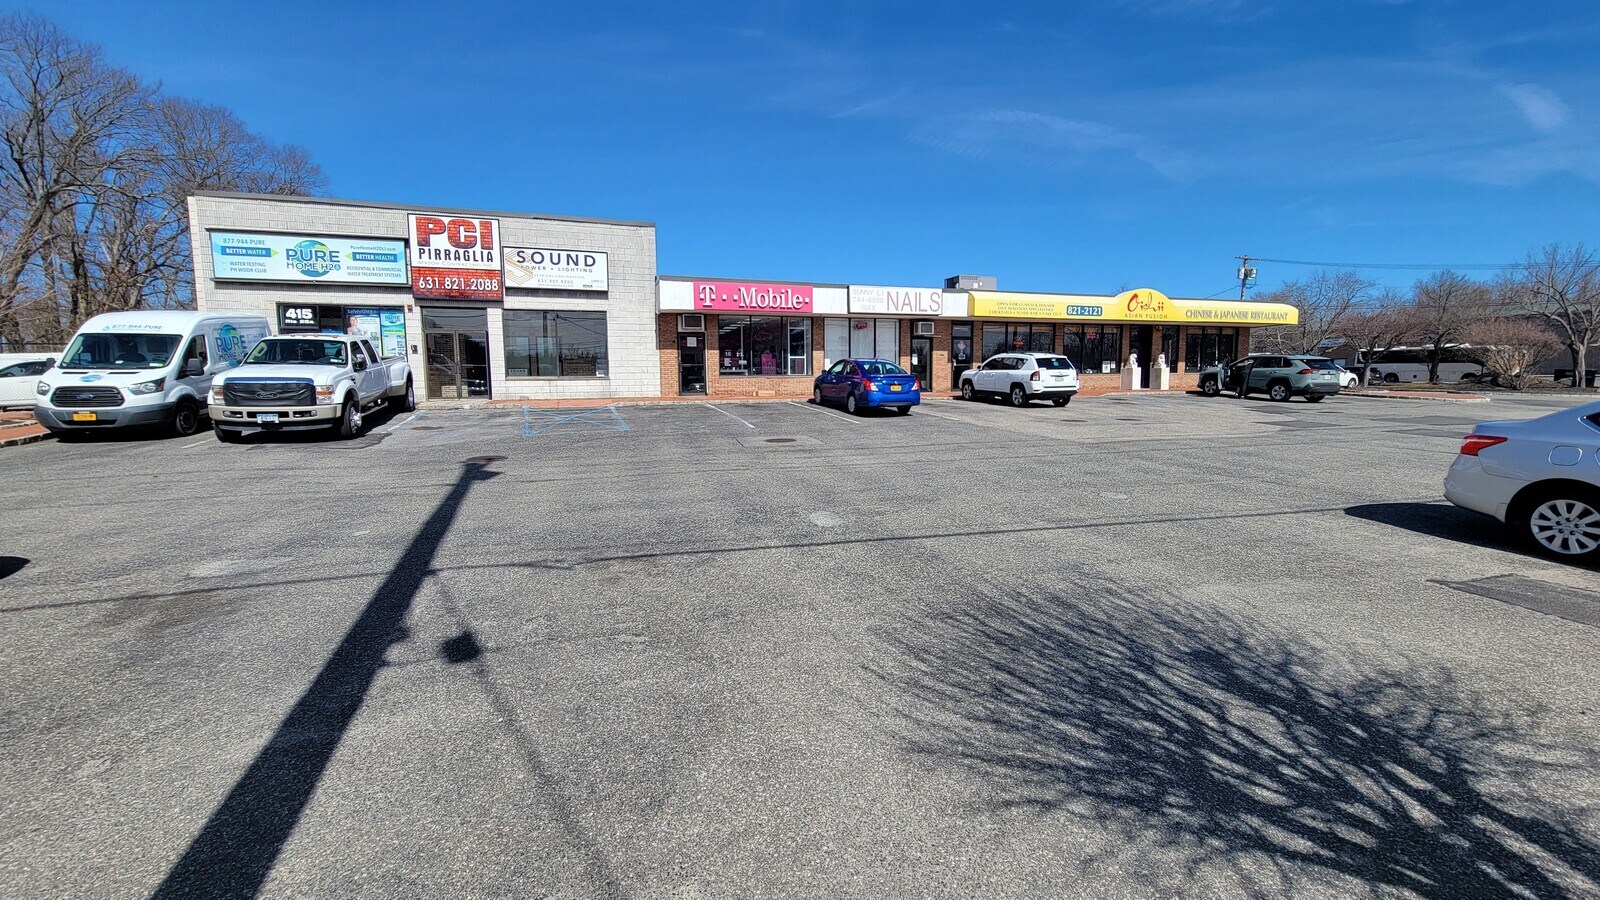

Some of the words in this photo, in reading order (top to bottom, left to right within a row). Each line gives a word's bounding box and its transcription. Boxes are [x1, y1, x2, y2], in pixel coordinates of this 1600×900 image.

[415, 215, 494, 250] PCI
[285, 248, 341, 263] PURE
[418, 247, 494, 263] PIRRAGLIA
[516, 250, 596, 267] SOUND
[286, 261, 318, 270] HOME
[321, 263, 341, 271] H2O
[441, 260, 482, 268] CONTRACTING
[418, 276, 499, 291] 631.821.2088
[852, 288, 875, 296] SUNNY
[886, 290, 941, 313] NAILS
[285, 308, 313, 319] 415
[1066, 305, 1102, 316] 821-2121
[1185, 309, 1213, 318] CHINESE
[1219, 310, 1250, 320] JAPANESE
[1250, 311, 1288, 321] RESTAURANT
[215, 335, 248, 353] PURE
